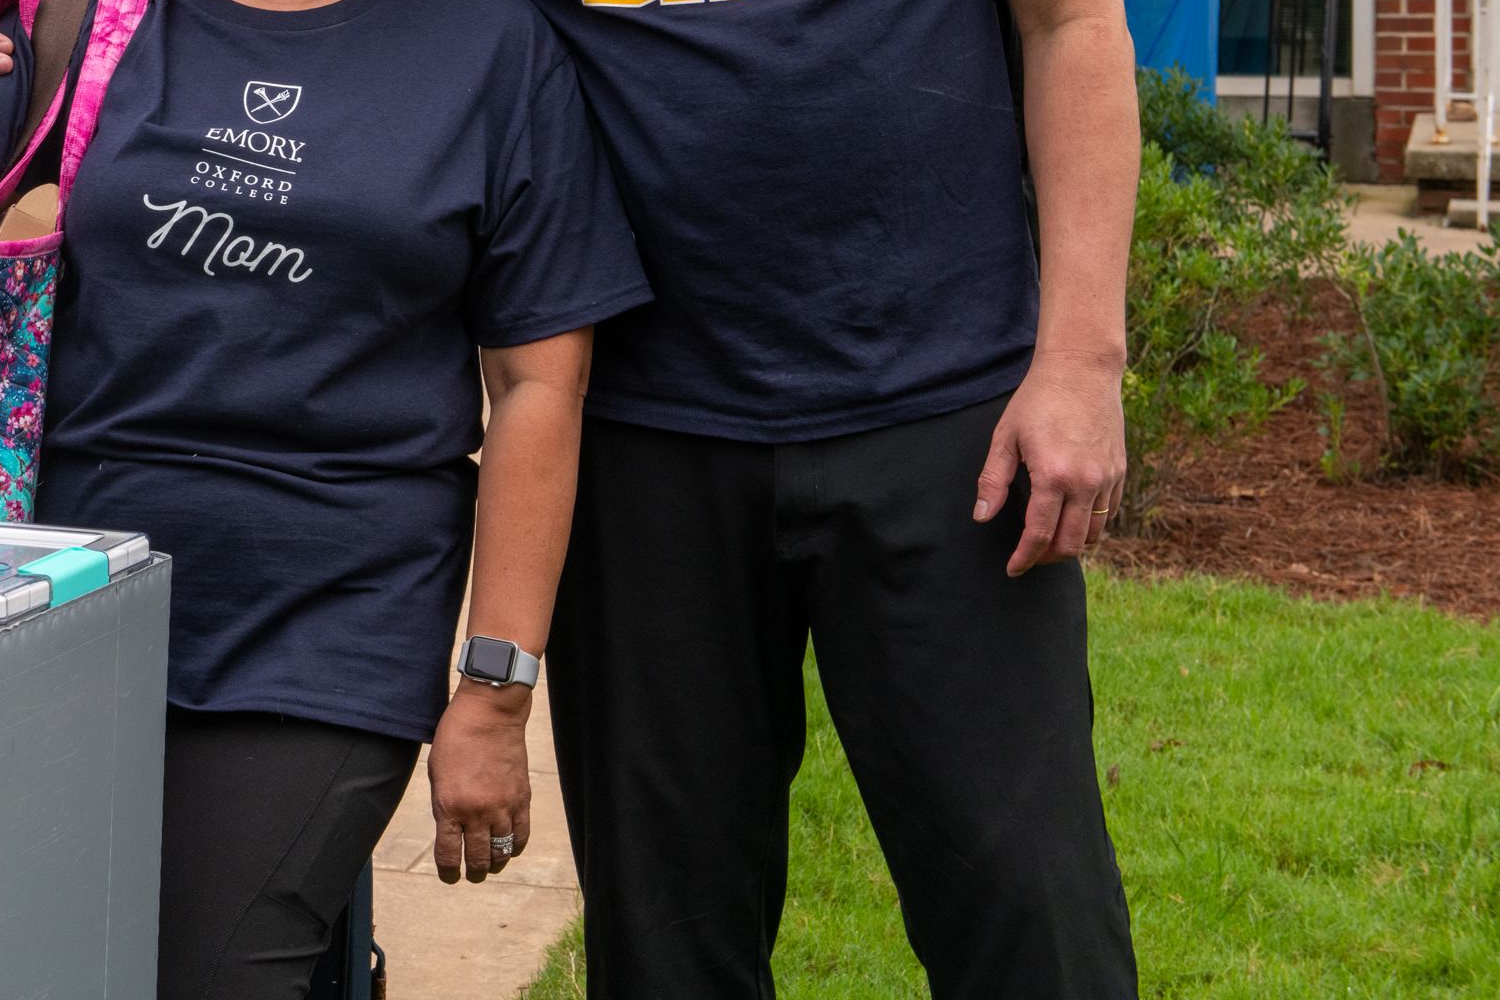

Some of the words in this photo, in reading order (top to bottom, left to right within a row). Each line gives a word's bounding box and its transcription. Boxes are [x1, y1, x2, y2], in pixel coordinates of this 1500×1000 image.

[190, 176, 289, 205] COLLEGE
[195, 161, 292, 192] OXFORD
[143, 193, 313, 283] Mom
